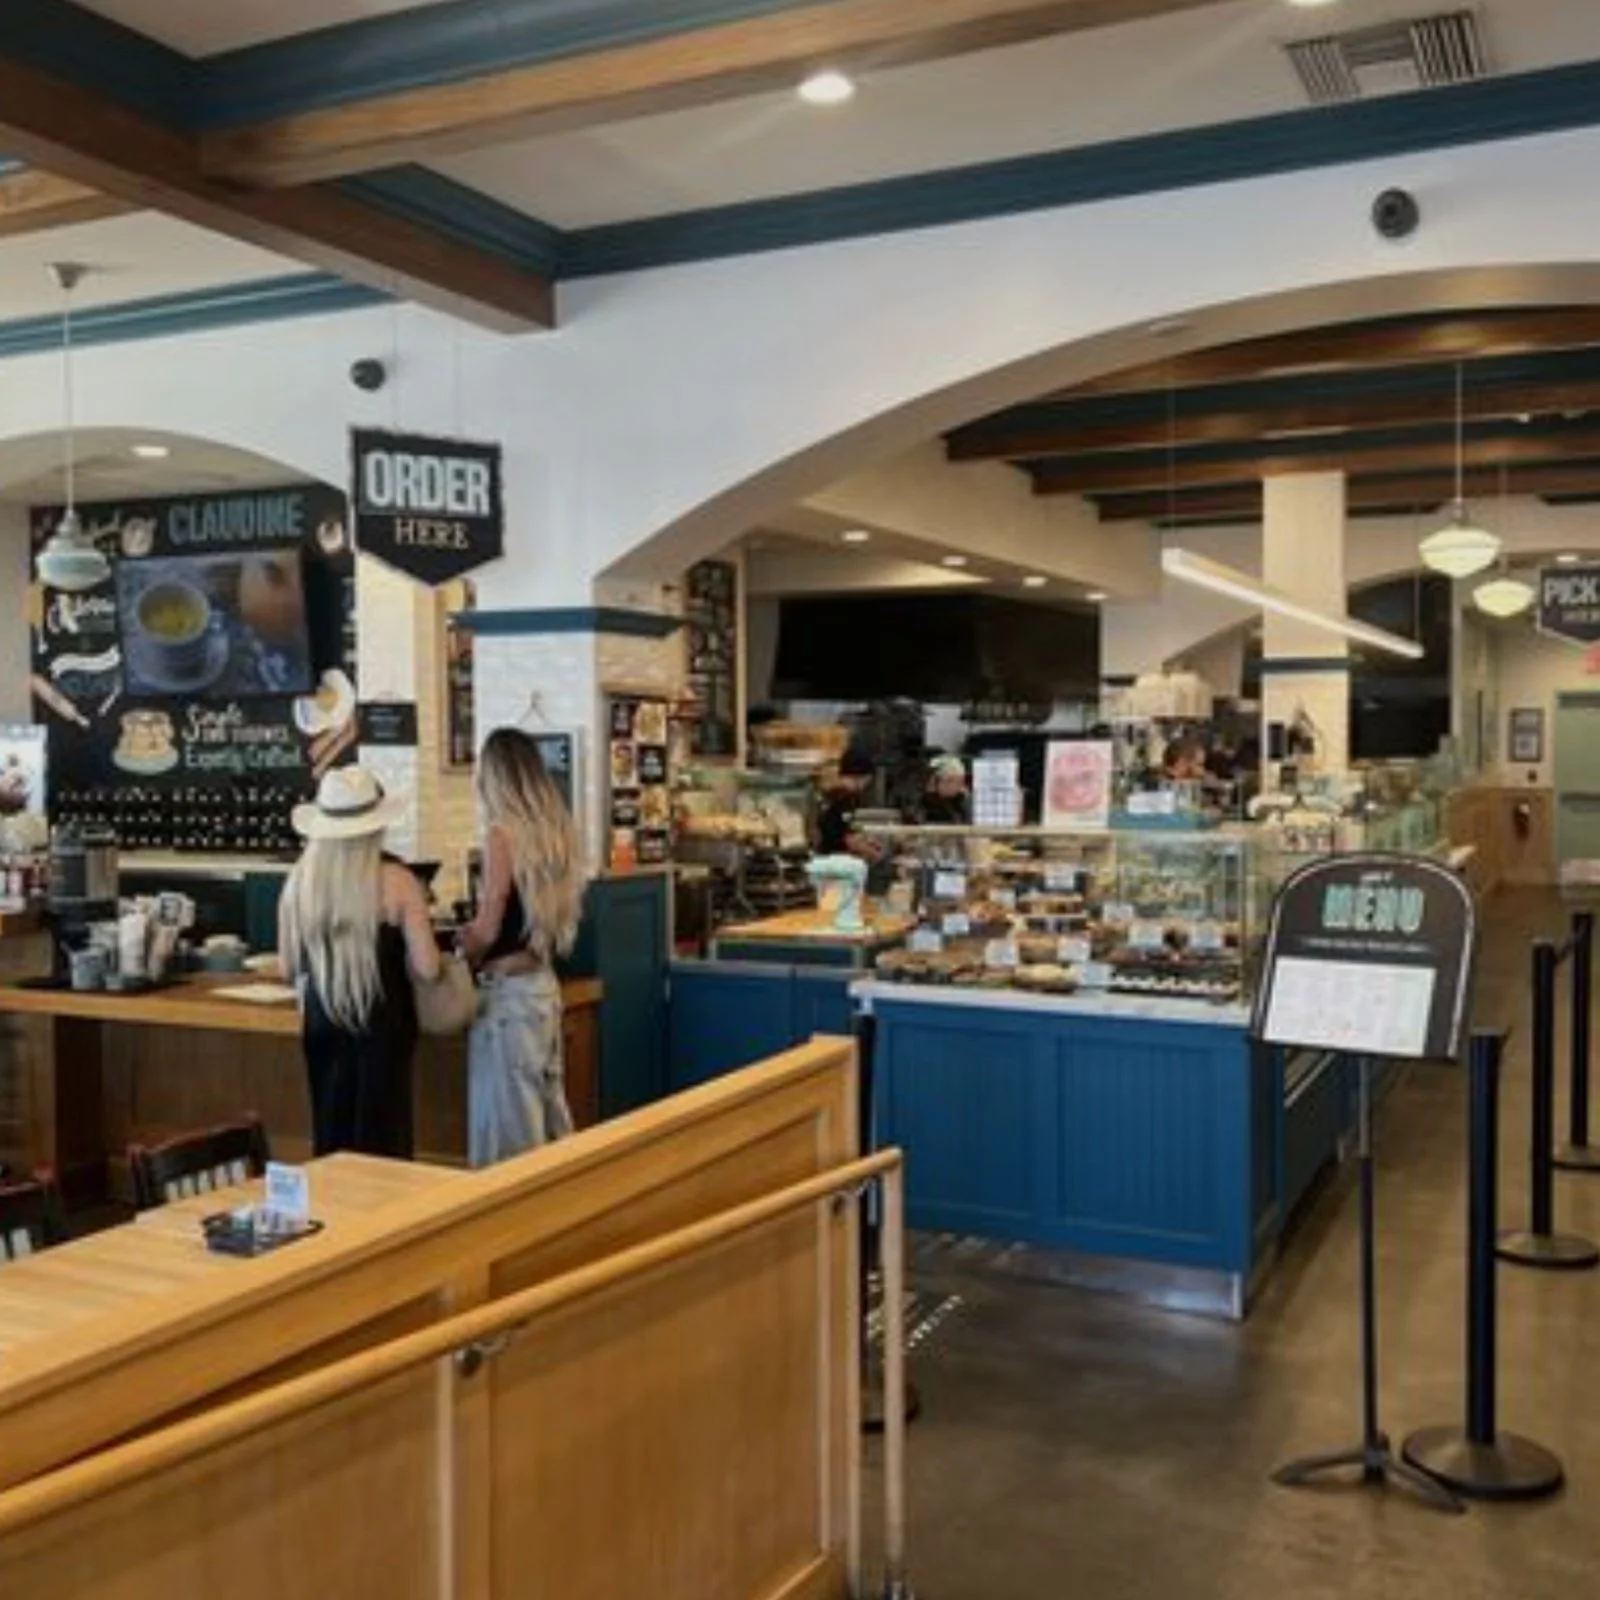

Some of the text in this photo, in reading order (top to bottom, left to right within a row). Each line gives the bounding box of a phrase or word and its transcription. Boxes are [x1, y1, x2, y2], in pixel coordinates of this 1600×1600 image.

[366, 451, 490, 515] ORDER
[395, 518, 469, 549] HERE
[1544, 576, 1599, 607] PICK
[1322, 883, 1425, 936] MENU
